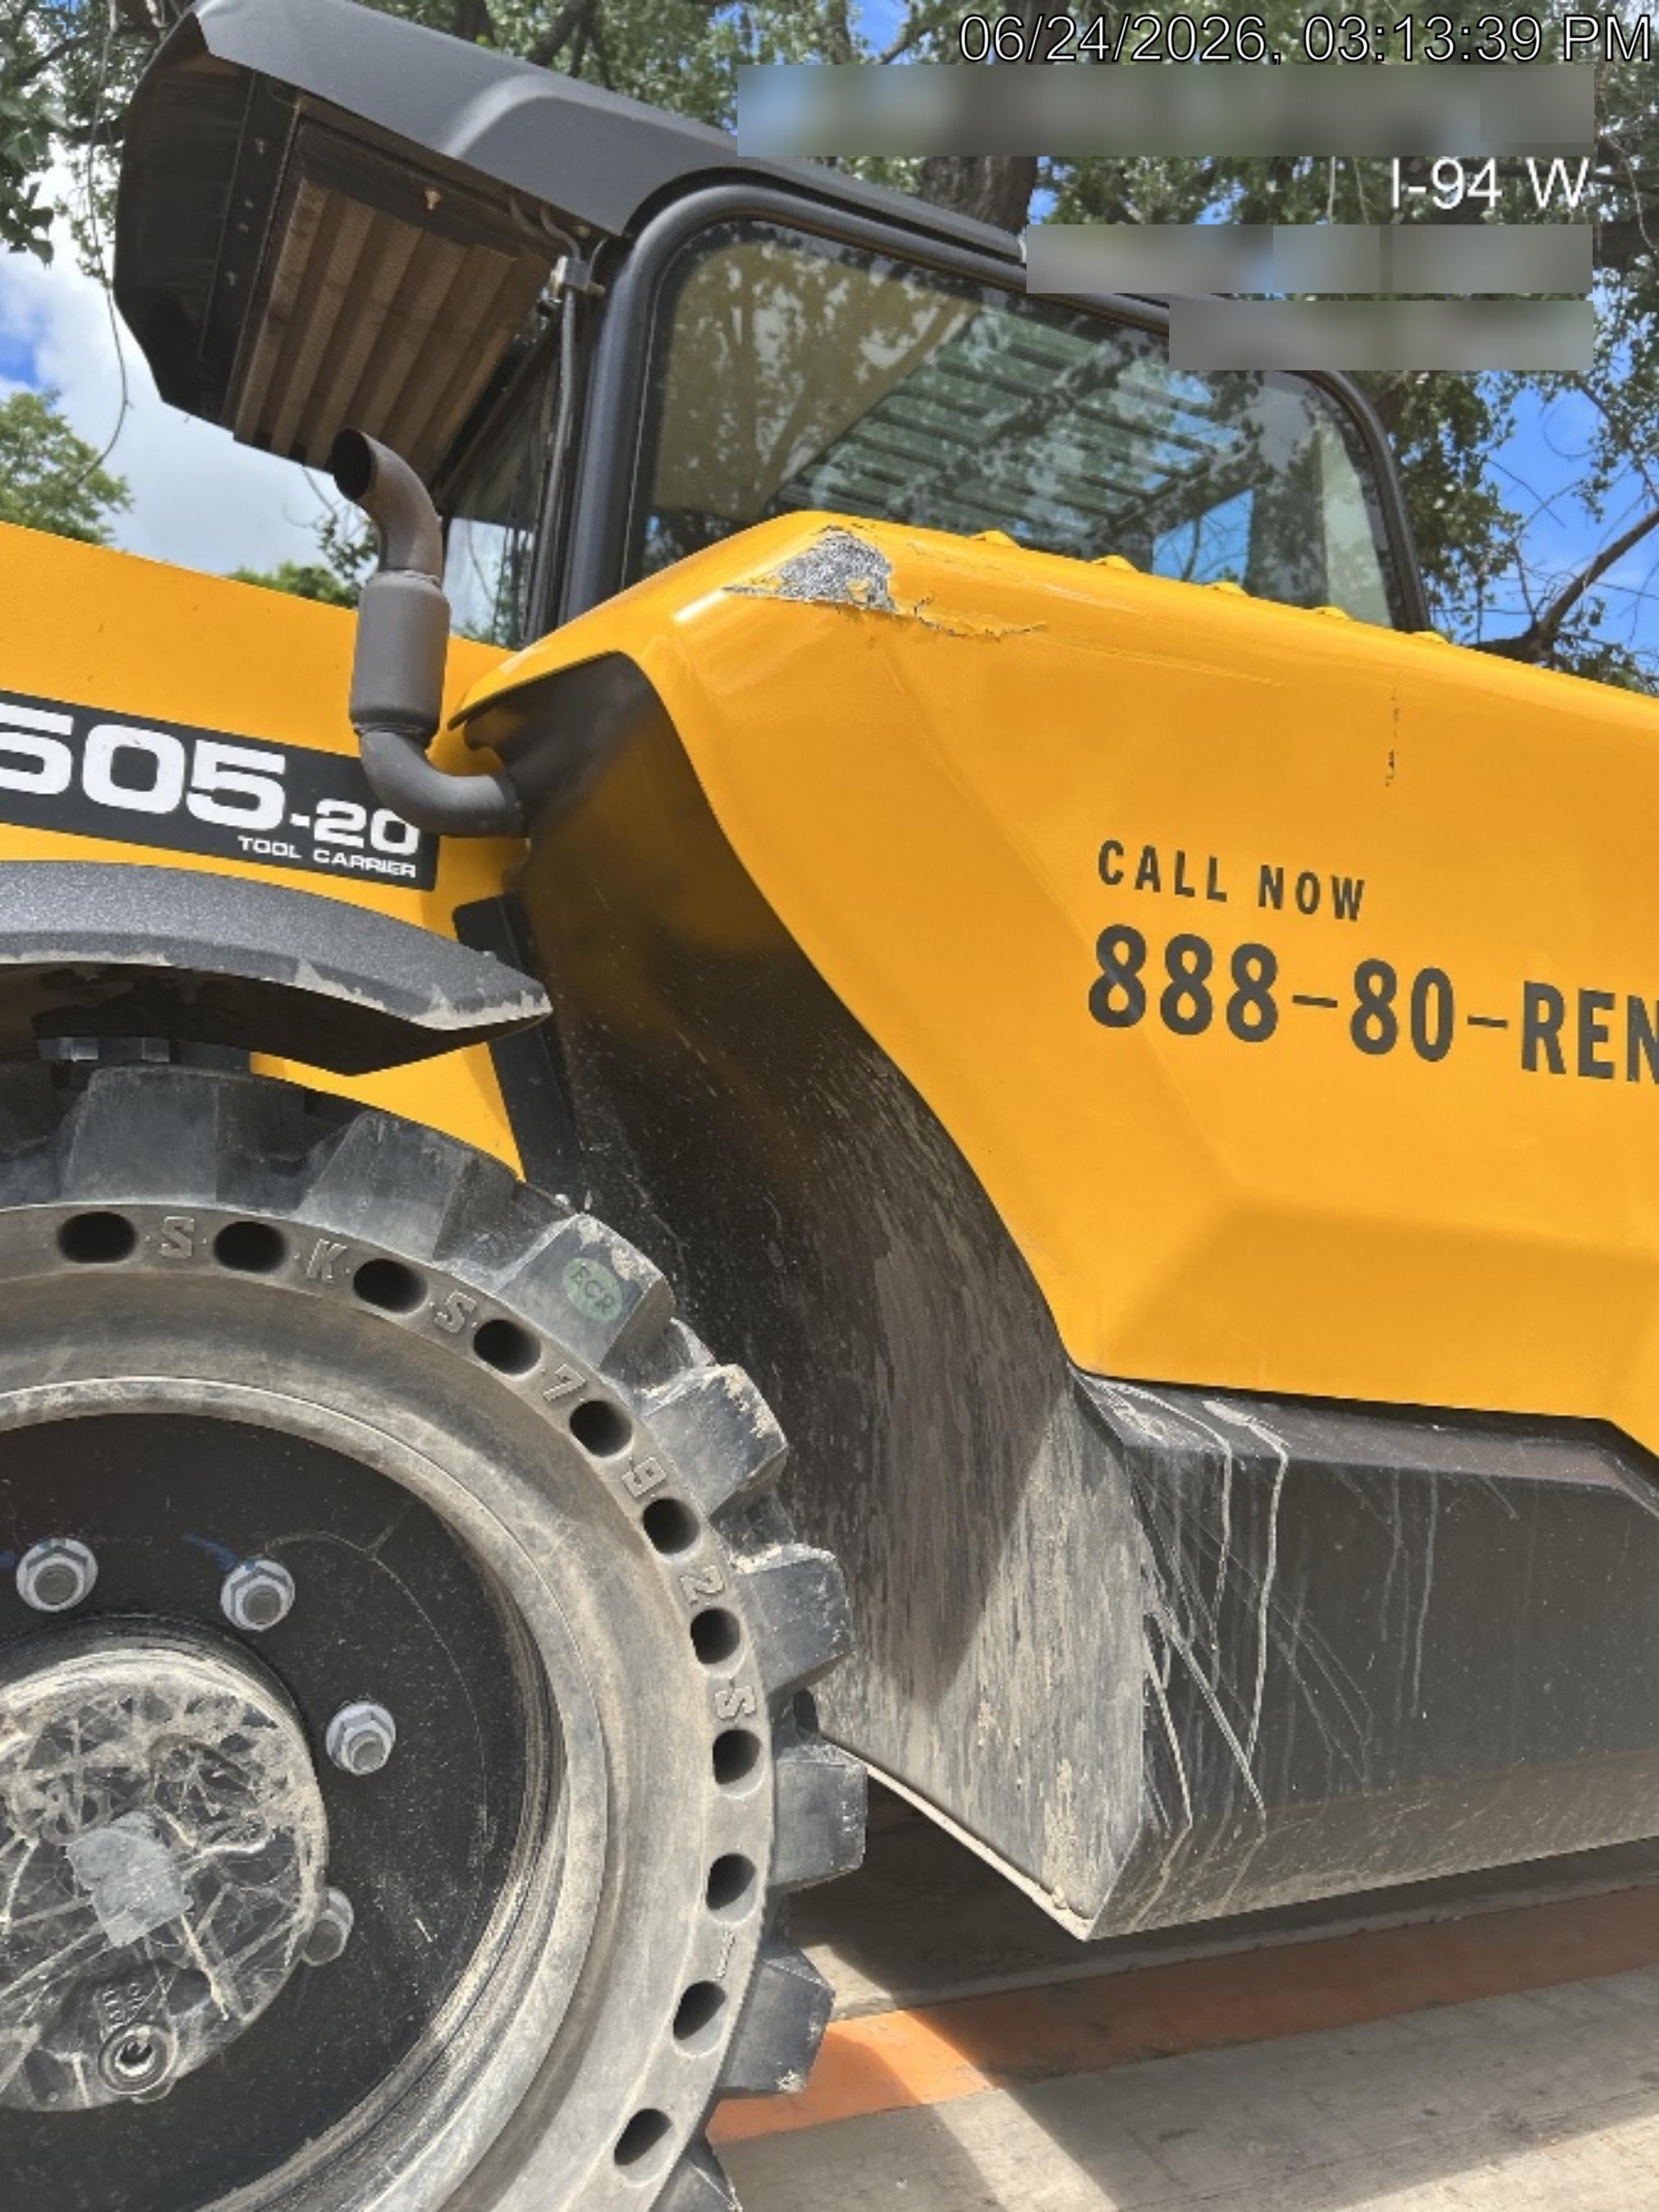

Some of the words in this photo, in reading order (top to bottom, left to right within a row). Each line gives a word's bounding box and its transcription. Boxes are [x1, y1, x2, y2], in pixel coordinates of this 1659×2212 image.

[238, 835, 302, 859] TOOL
[313, 848, 416, 878] CARRIER
[1098, 839, 1228, 903] CALL
[1258, 863, 1366, 921] NOW
